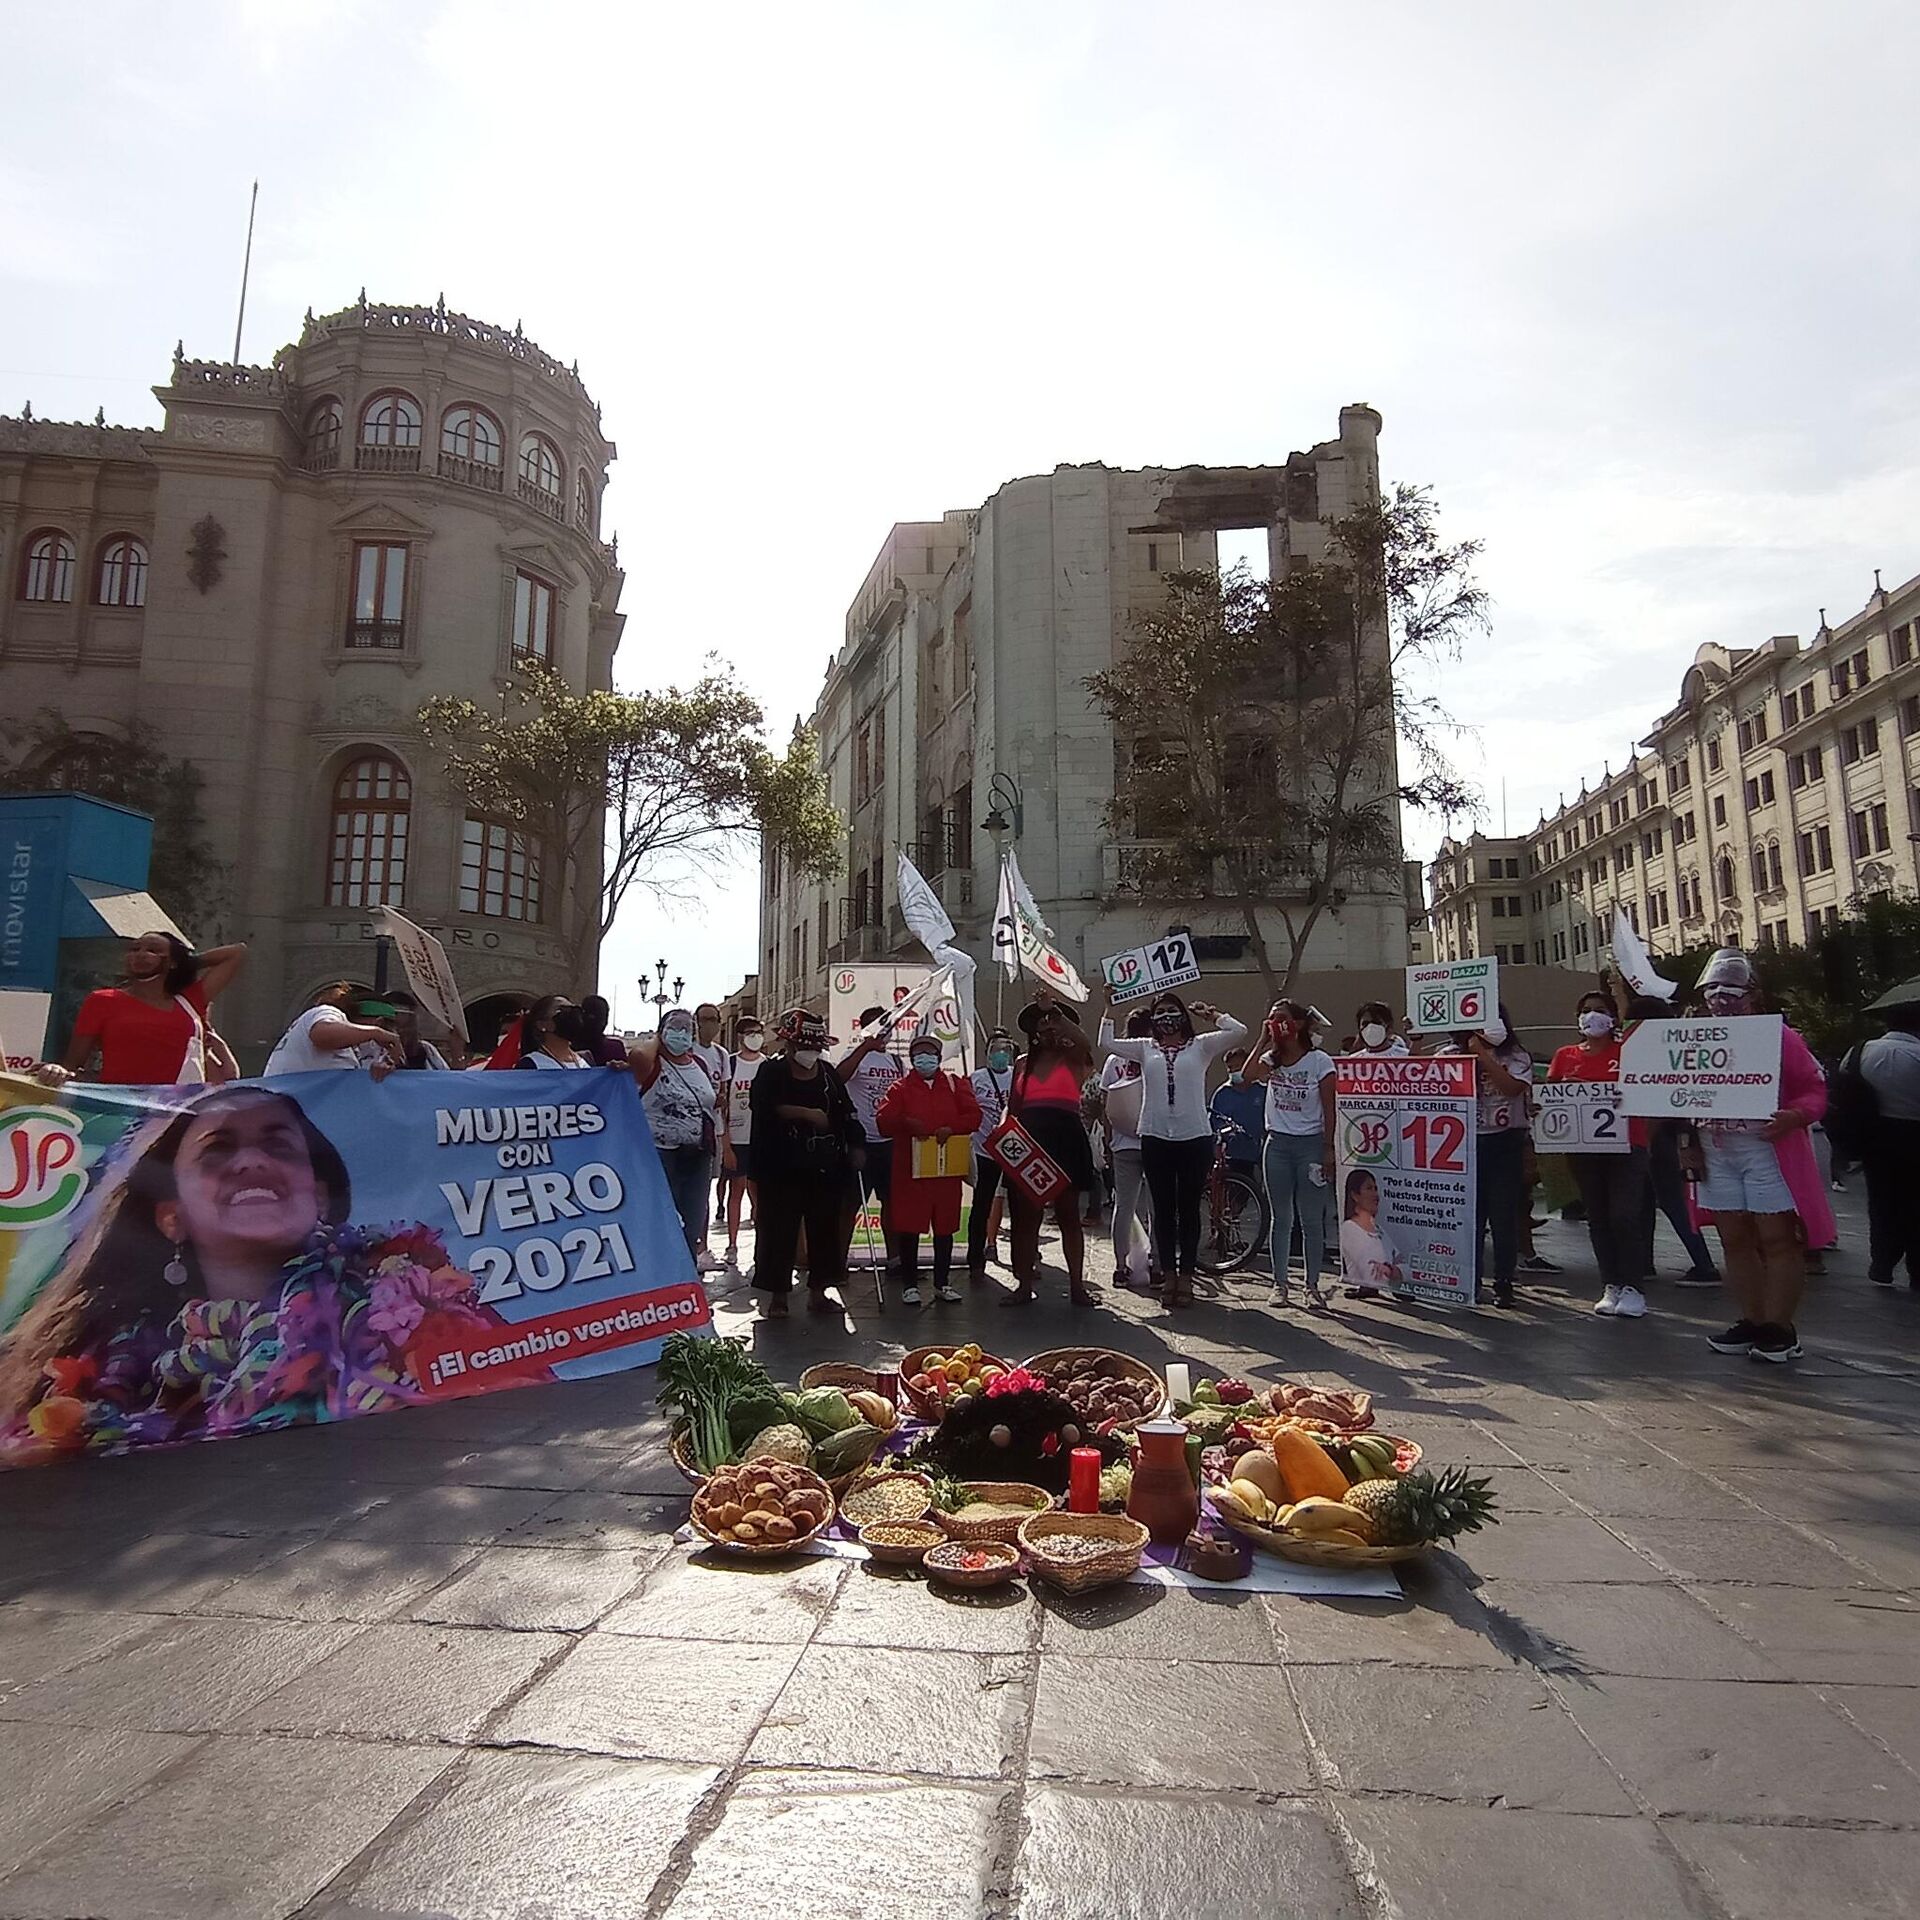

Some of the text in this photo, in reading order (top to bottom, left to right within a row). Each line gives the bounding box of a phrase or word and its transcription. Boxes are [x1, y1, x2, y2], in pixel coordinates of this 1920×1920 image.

[3, 841, 32, 966] movistar
[329, 922, 500, 948] TETRO
[1152, 940, 1191, 974] 12
[1156, 976, 1185, 989] ESCRIBE
[1414, 970, 1450, 982] SIGRID
[1113, 989, 1138, 1002] MARCA
[1460, 992, 1478, 1018] 6
[1667, 1027, 1729, 1043] MUJERES
[1668, 1048, 1728, 1071] VERO
[1337, 1060, 1464, 1082] HUAYCÁN
[1624, 1073, 1773, 1085] EL CAMBIO VERDADERO
[1352, 1082, 1450, 1094] AL CONGRESO
[1540, 1083, 1615, 1098] ANCASH
[1340, 1101, 1375, 1109] MARCA
[1407, 1102, 1458, 1111] ESCRIBE
[435, 1103, 606, 1144] MUJERES
[1495, 1107, 1510, 1127] 6
[1592, 1108, 1617, 1138] 2
[1402, 1115, 1465, 1171] 12
[0, 1129, 75, 1199] JP
[496, 1142, 552, 1168] CON
[1026, 1162, 1053, 1190] 13
[1404, 1178, 1412, 1187] la
[1414, 1179, 1451, 1191] defensa
[1453, 1182, 1466, 1192] de
[438, 1162, 624, 1237] VERO
[1383, 1189, 1466, 1206] Nuestros Recursos
[1386, 1215, 1413, 1225] medio
[1392, 1202, 1455, 1219] Naturales y el
[467, 1222, 635, 1305] 2021
[1400, 1283, 1464, 1302] AL CONGRESO
[430, 1292, 701, 1386] ¡El cambio verdadero!
